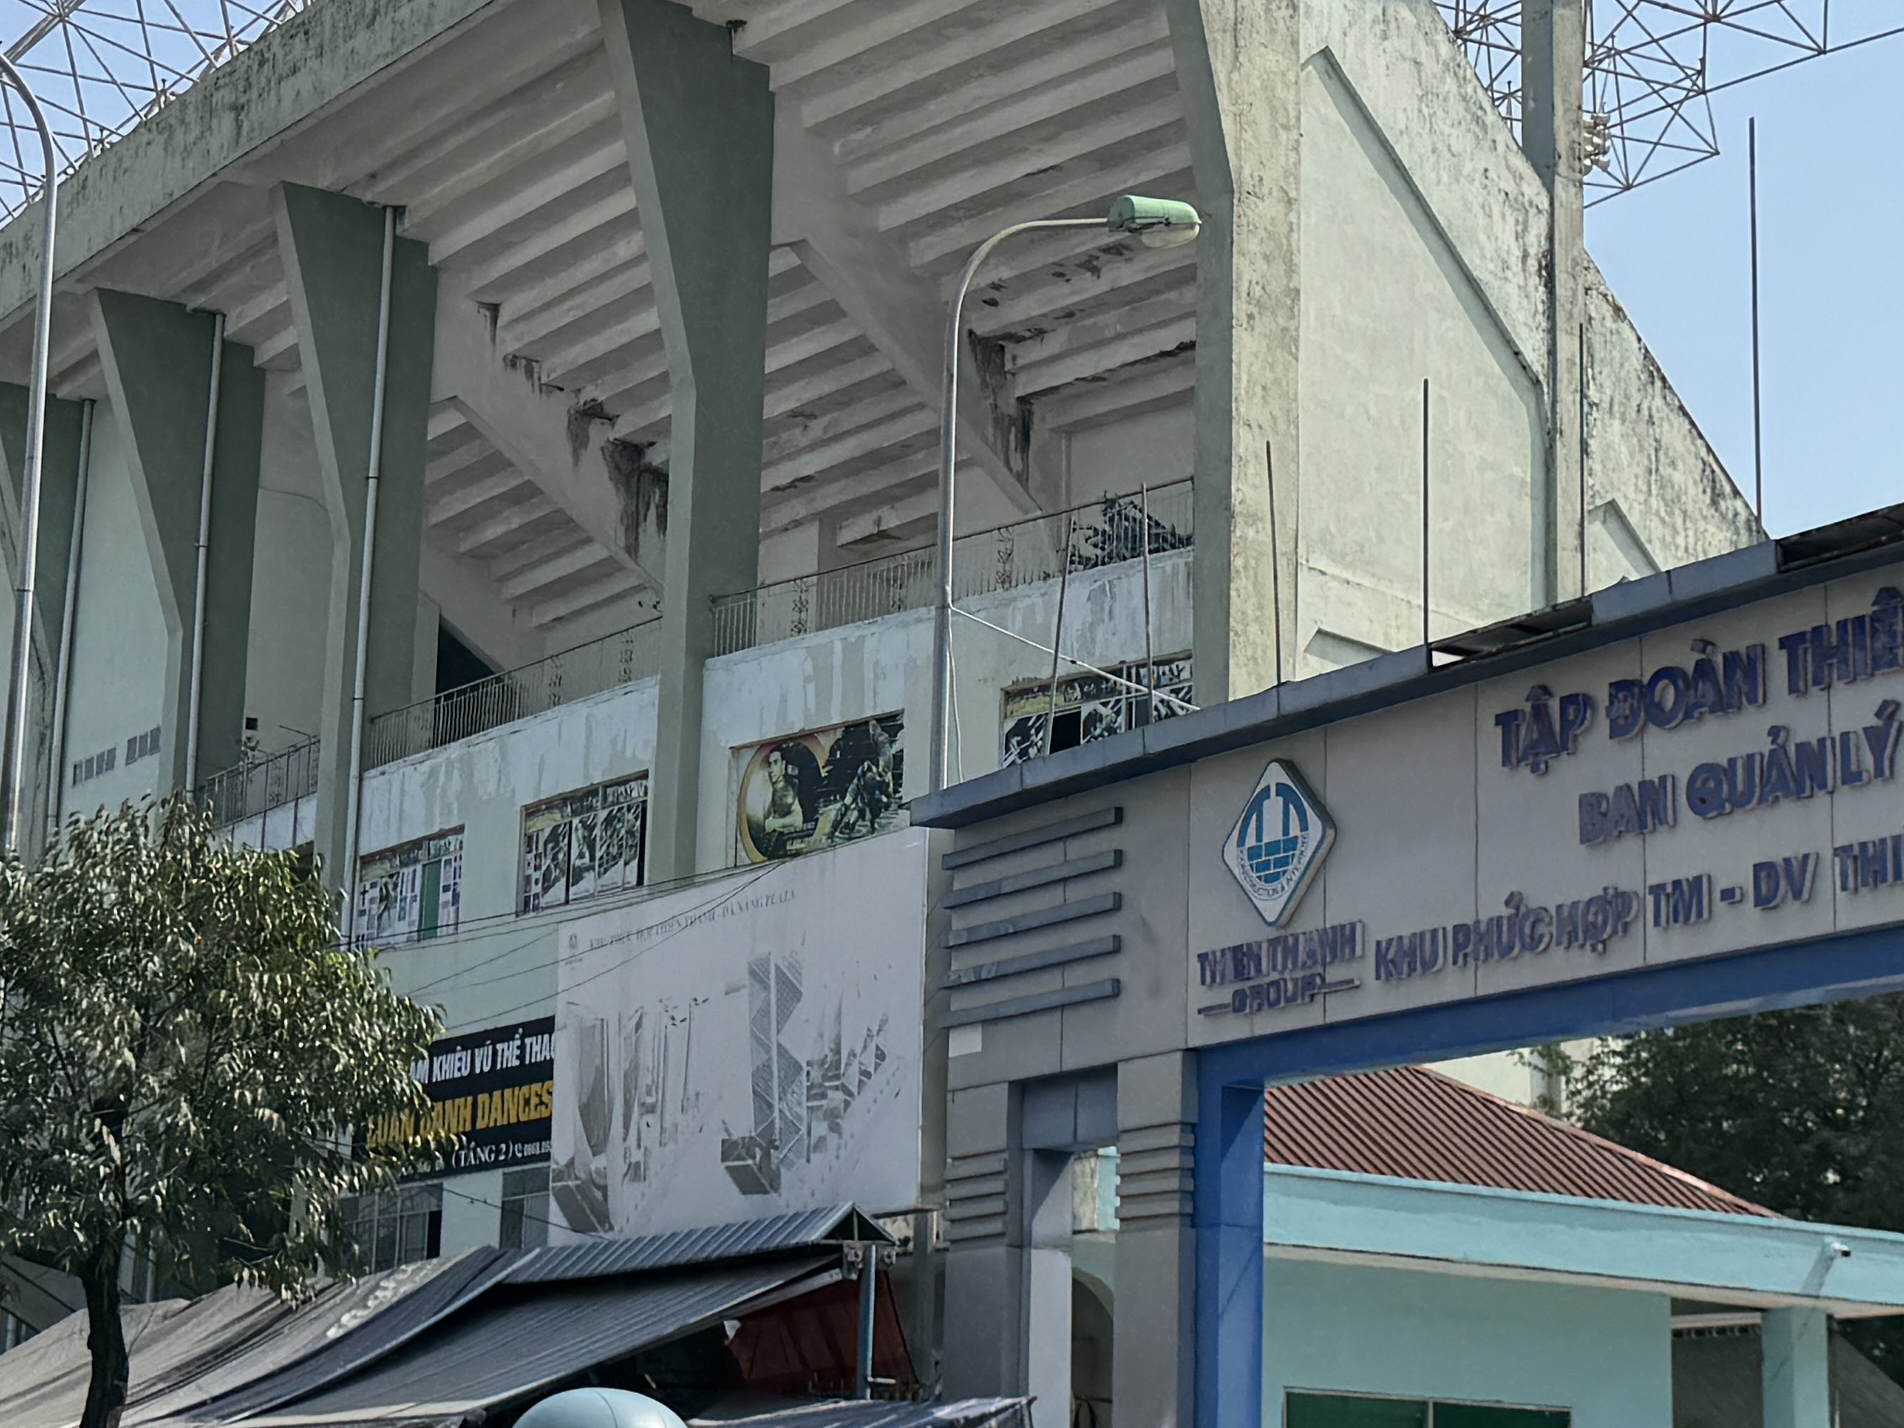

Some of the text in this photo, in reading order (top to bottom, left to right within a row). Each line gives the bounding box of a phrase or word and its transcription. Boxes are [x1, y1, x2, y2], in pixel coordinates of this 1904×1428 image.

[1495, 684, 1593, 776] TẬP
[1607, 638, 1767, 741] ĐOÀN
[1579, 774, 1676, 846] BAN
[1686, 724, 1836, 819] QUẢN
[1839, 699, 1902, 787] LÝ
[1375, 926, 1446, 981] KHU
[1452, 890, 1553, 967] PHỨC
[1555, 885, 1639, 954] HỢP
[1648, 873, 1712, 929] TM
[1753, 851, 1819, 911] DV
